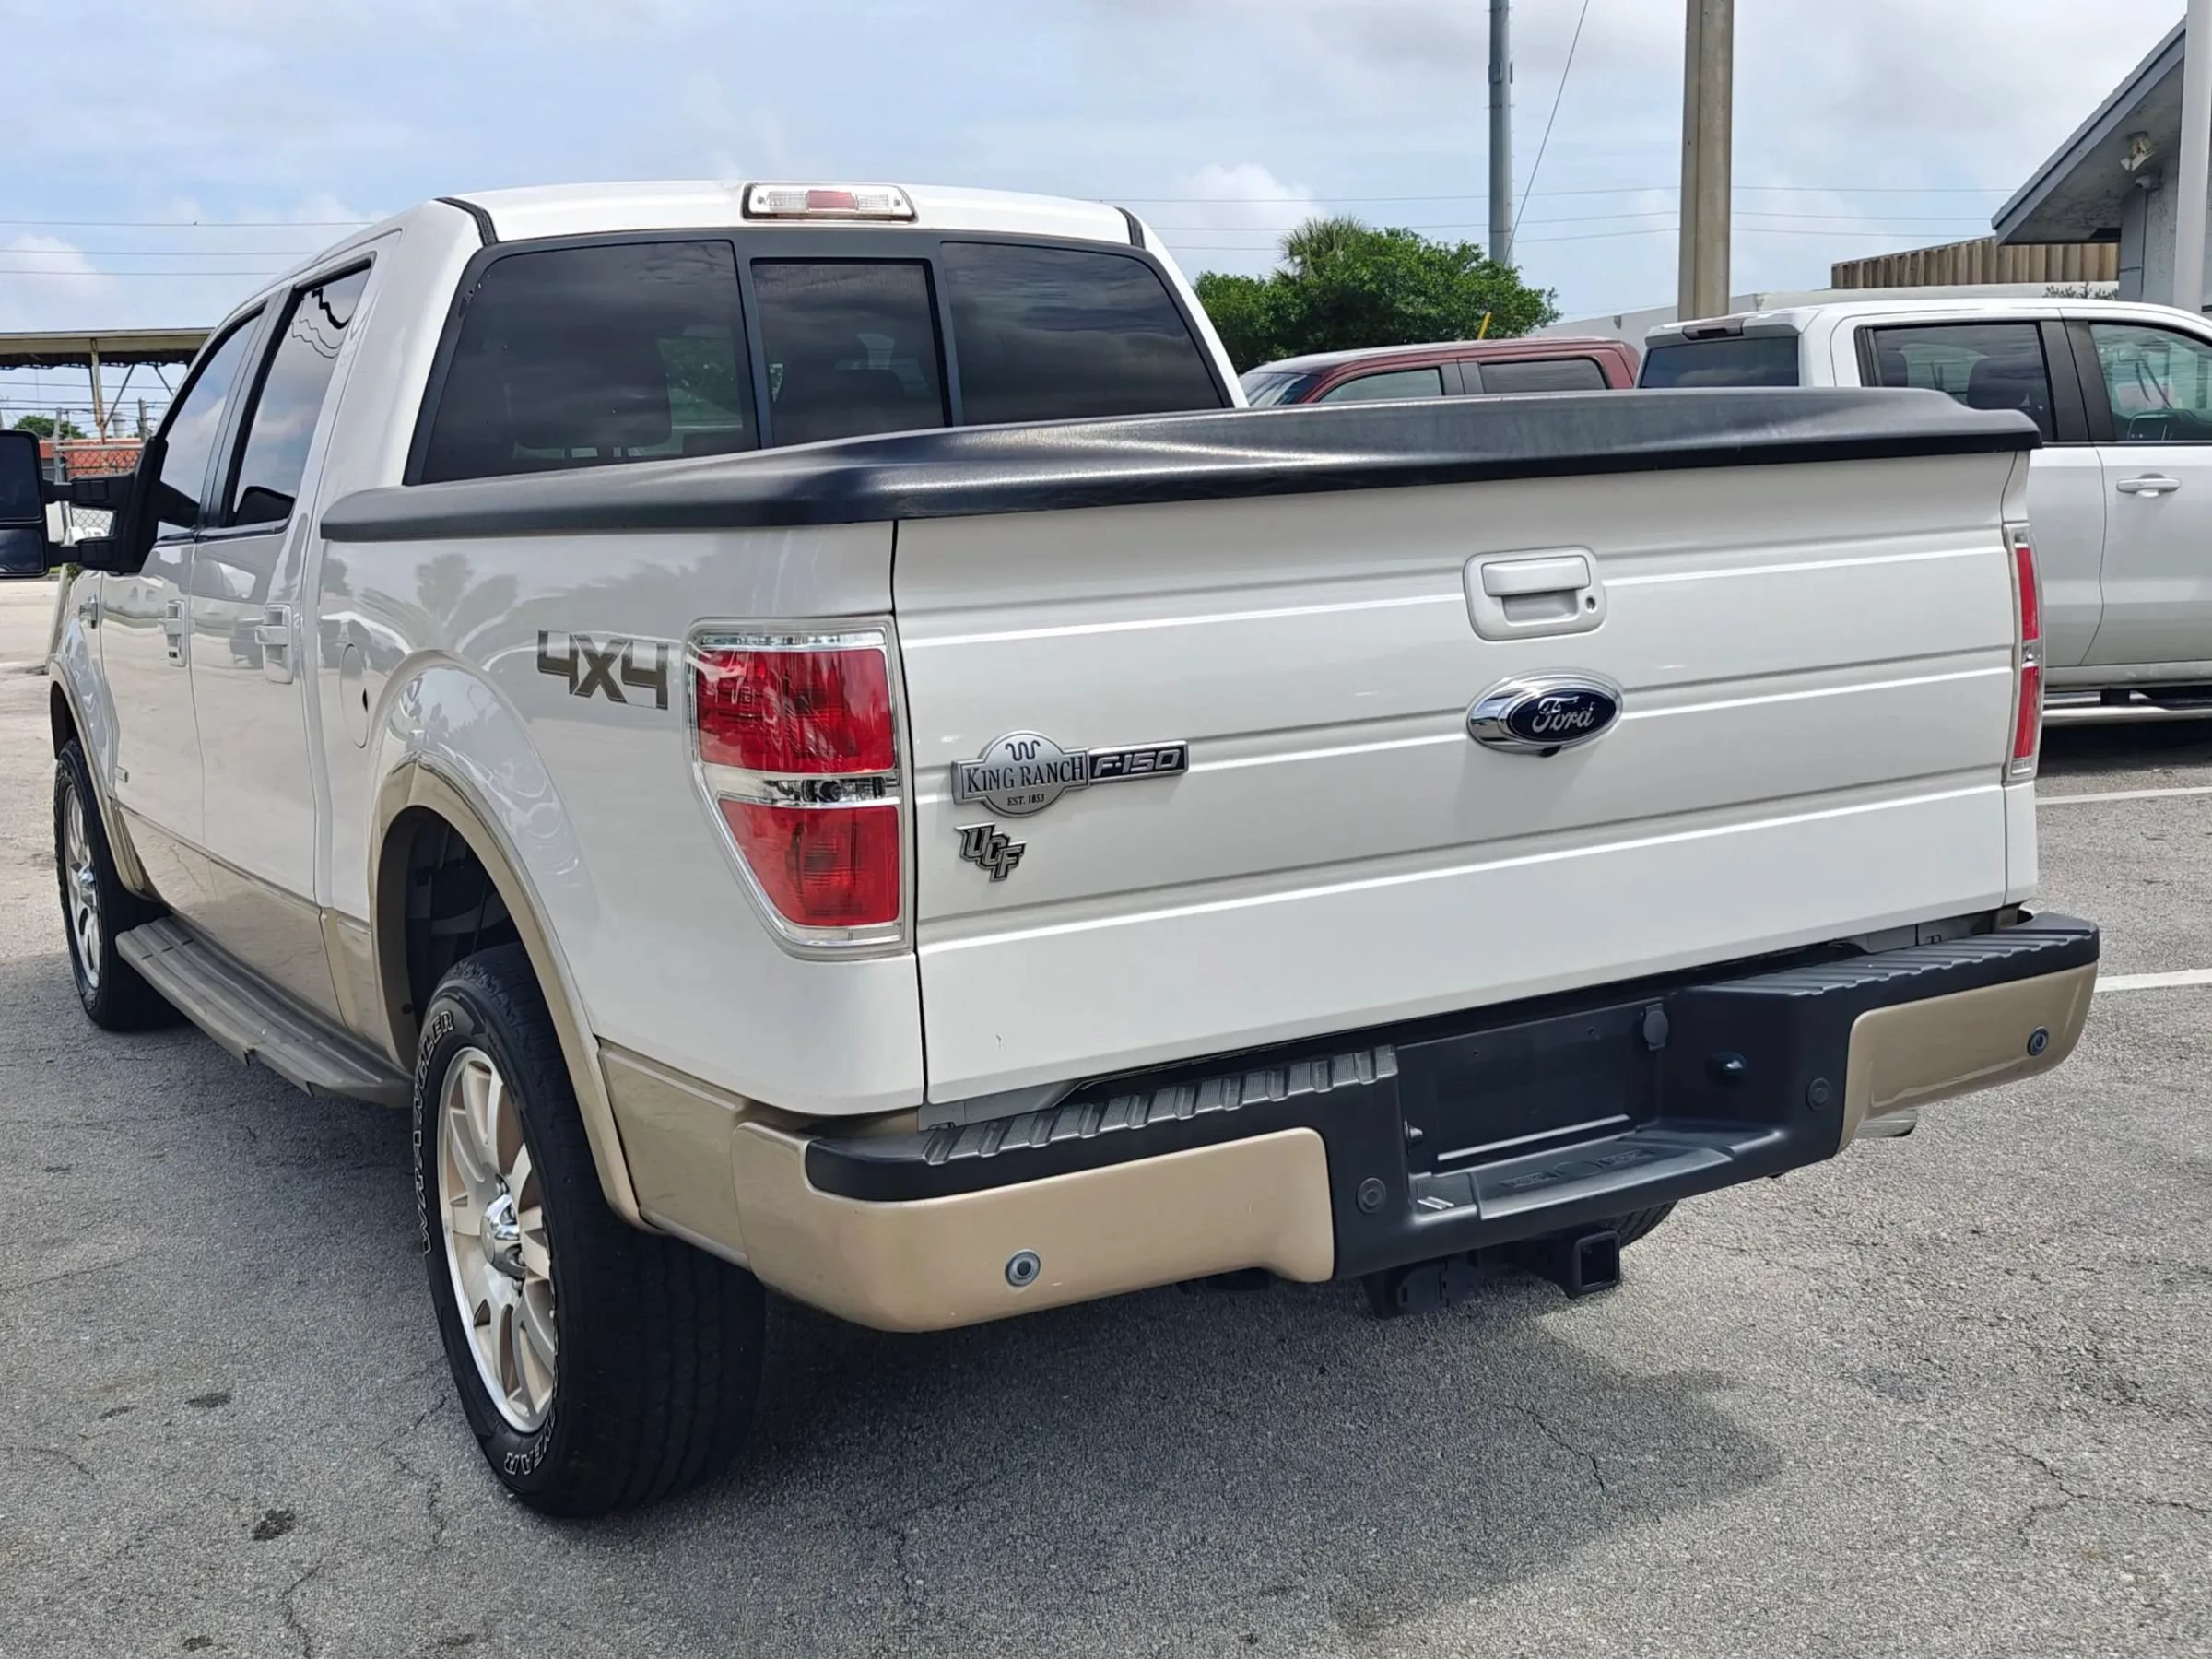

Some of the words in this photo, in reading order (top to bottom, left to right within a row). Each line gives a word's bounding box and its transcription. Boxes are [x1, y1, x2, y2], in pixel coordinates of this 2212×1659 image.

[1532, 696, 1595, 733] Ford
[967, 766, 1016, 794] KING
[1020, 756, 1085, 787] RANCH
[1093, 748, 1181, 778] F-150
[1006, 796, 1026, 806] EST.
[1028, 793, 1045, 805] 1853
[957, 823, 1026, 881] UCF
[413, 1010, 454, 1254] WRANGLER
